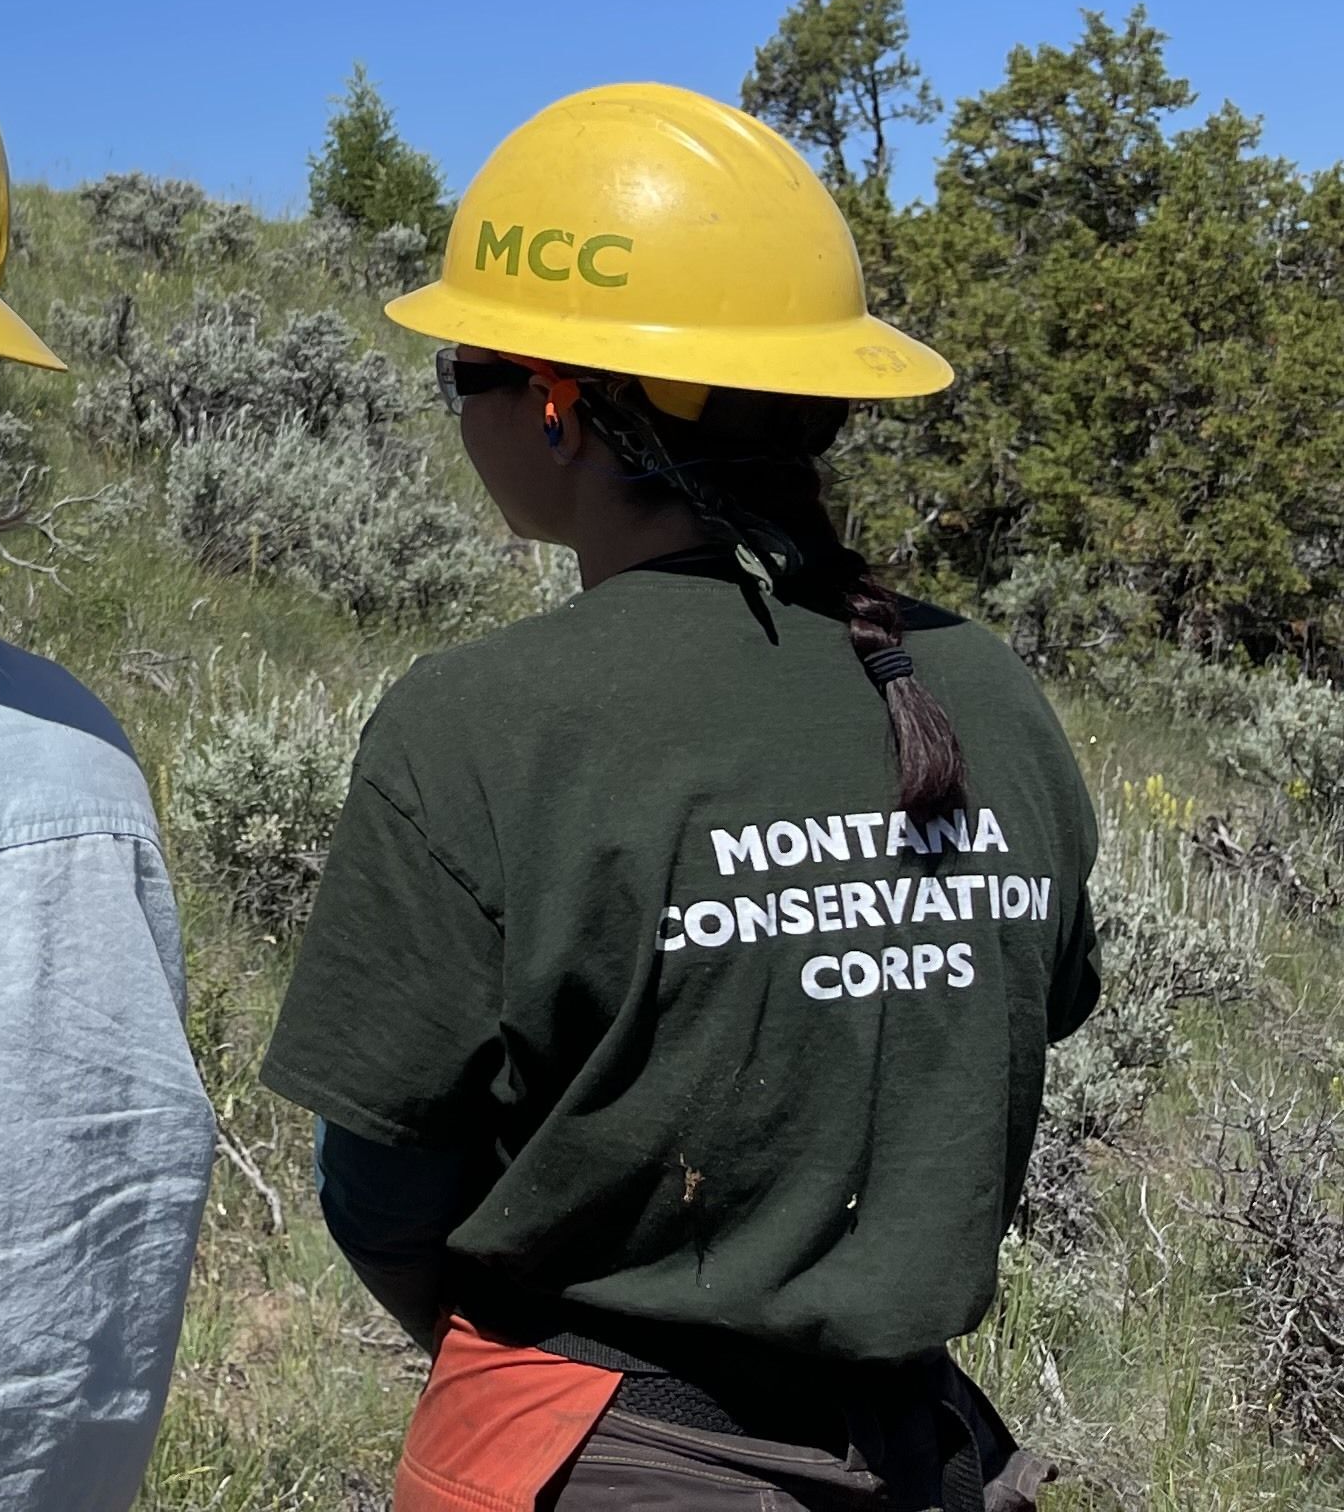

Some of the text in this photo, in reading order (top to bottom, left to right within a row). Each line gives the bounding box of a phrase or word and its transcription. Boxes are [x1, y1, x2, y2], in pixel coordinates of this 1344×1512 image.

[474, 220, 633, 287] MCC
[710, 808, 1009, 875] MONTANA
[655, 874, 1052, 952] CONSERVATION
[801, 942, 976, 1000] CORPS
